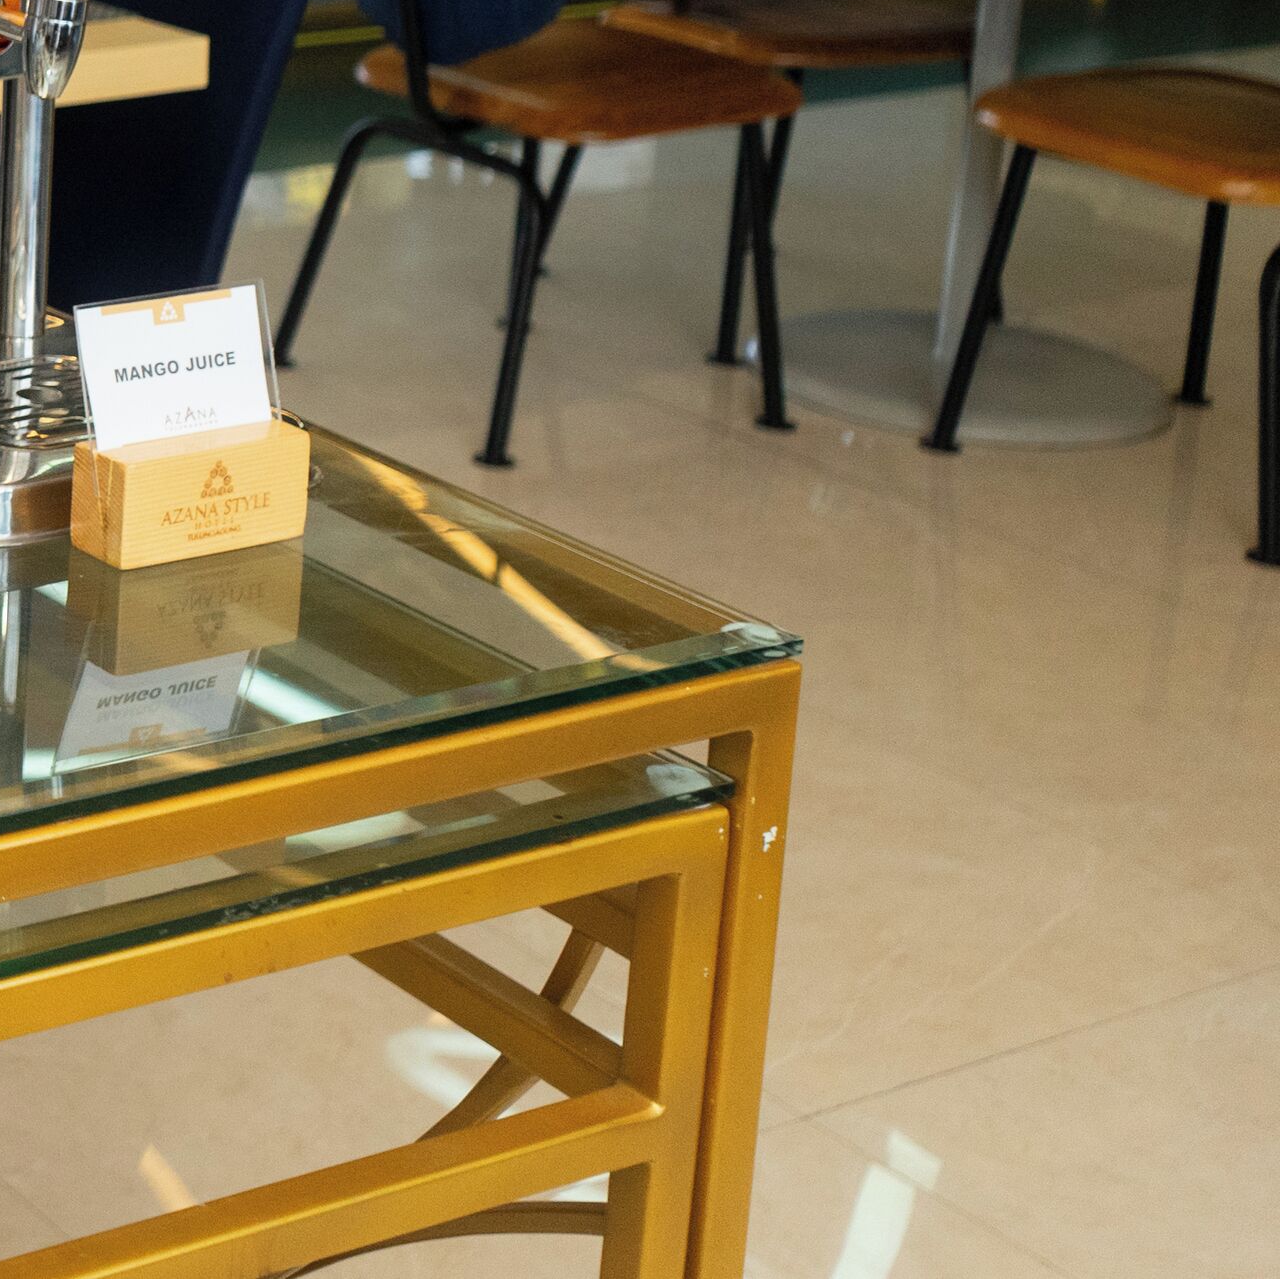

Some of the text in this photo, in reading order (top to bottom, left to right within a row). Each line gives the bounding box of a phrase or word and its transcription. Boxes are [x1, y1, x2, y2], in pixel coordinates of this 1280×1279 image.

[114, 351, 236, 382] MANGO JUICE
[164, 406, 216, 424] AZANA
[161, 491, 270, 525] AZANA STYLE
